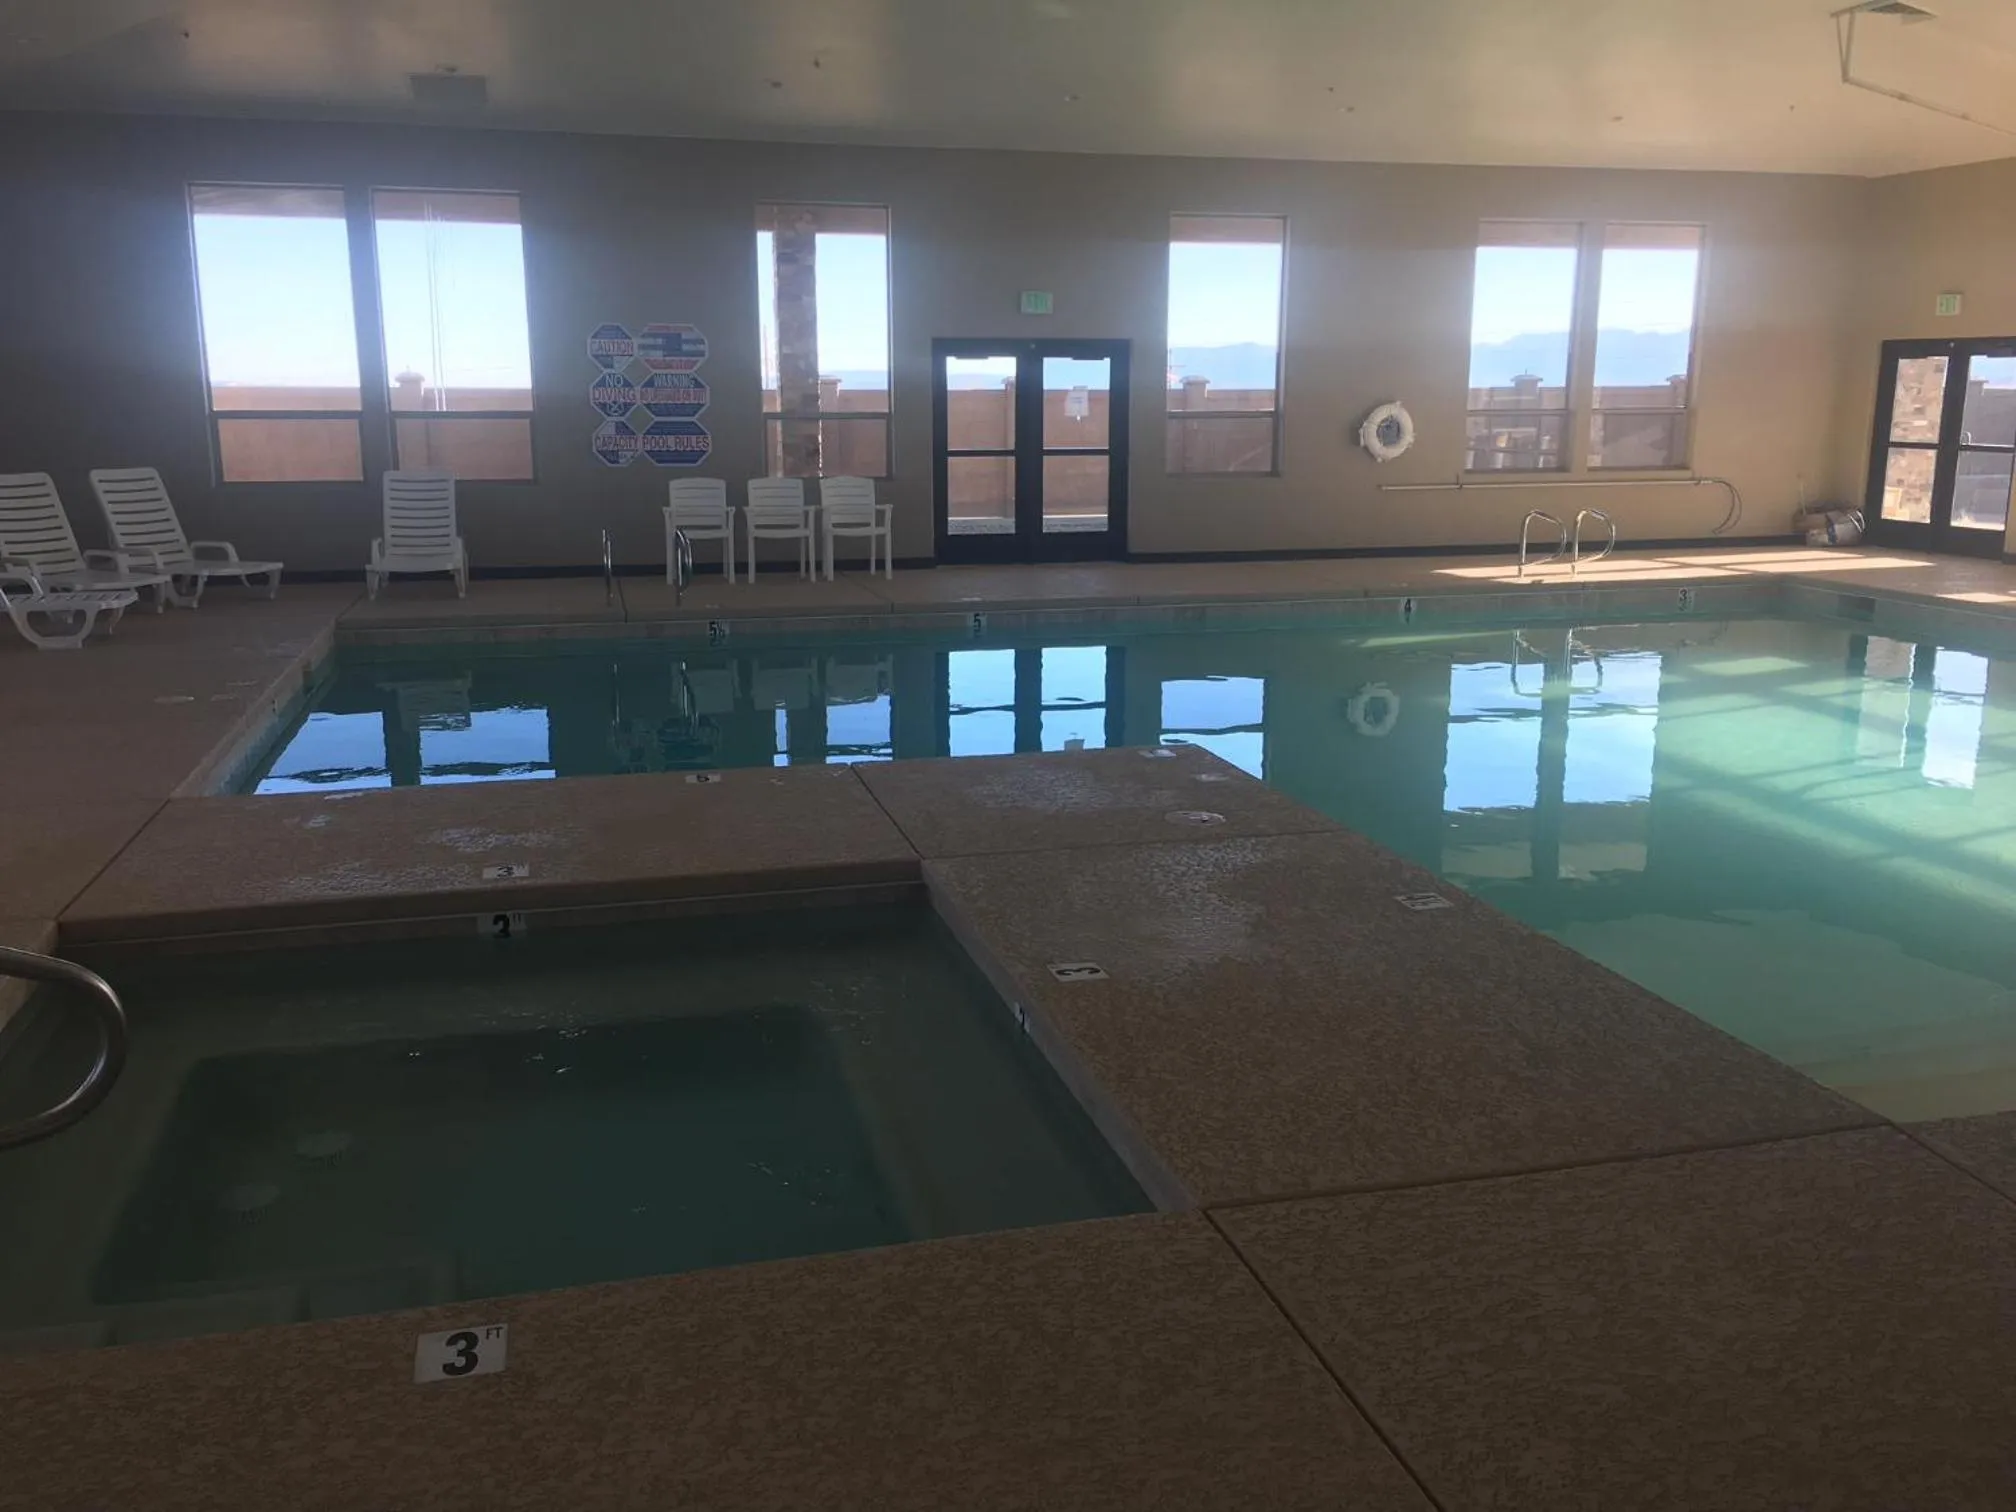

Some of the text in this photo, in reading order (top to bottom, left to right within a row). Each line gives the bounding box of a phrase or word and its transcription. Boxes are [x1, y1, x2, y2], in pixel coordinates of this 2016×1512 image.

[605, 374, 624, 388] NO
[592, 388, 636, 401] DIVING
[595, 435, 638, 450] CAPACITY
[641, 434, 709, 450] POOL RULES
[442, 1326, 504, 1377] 3 FT
